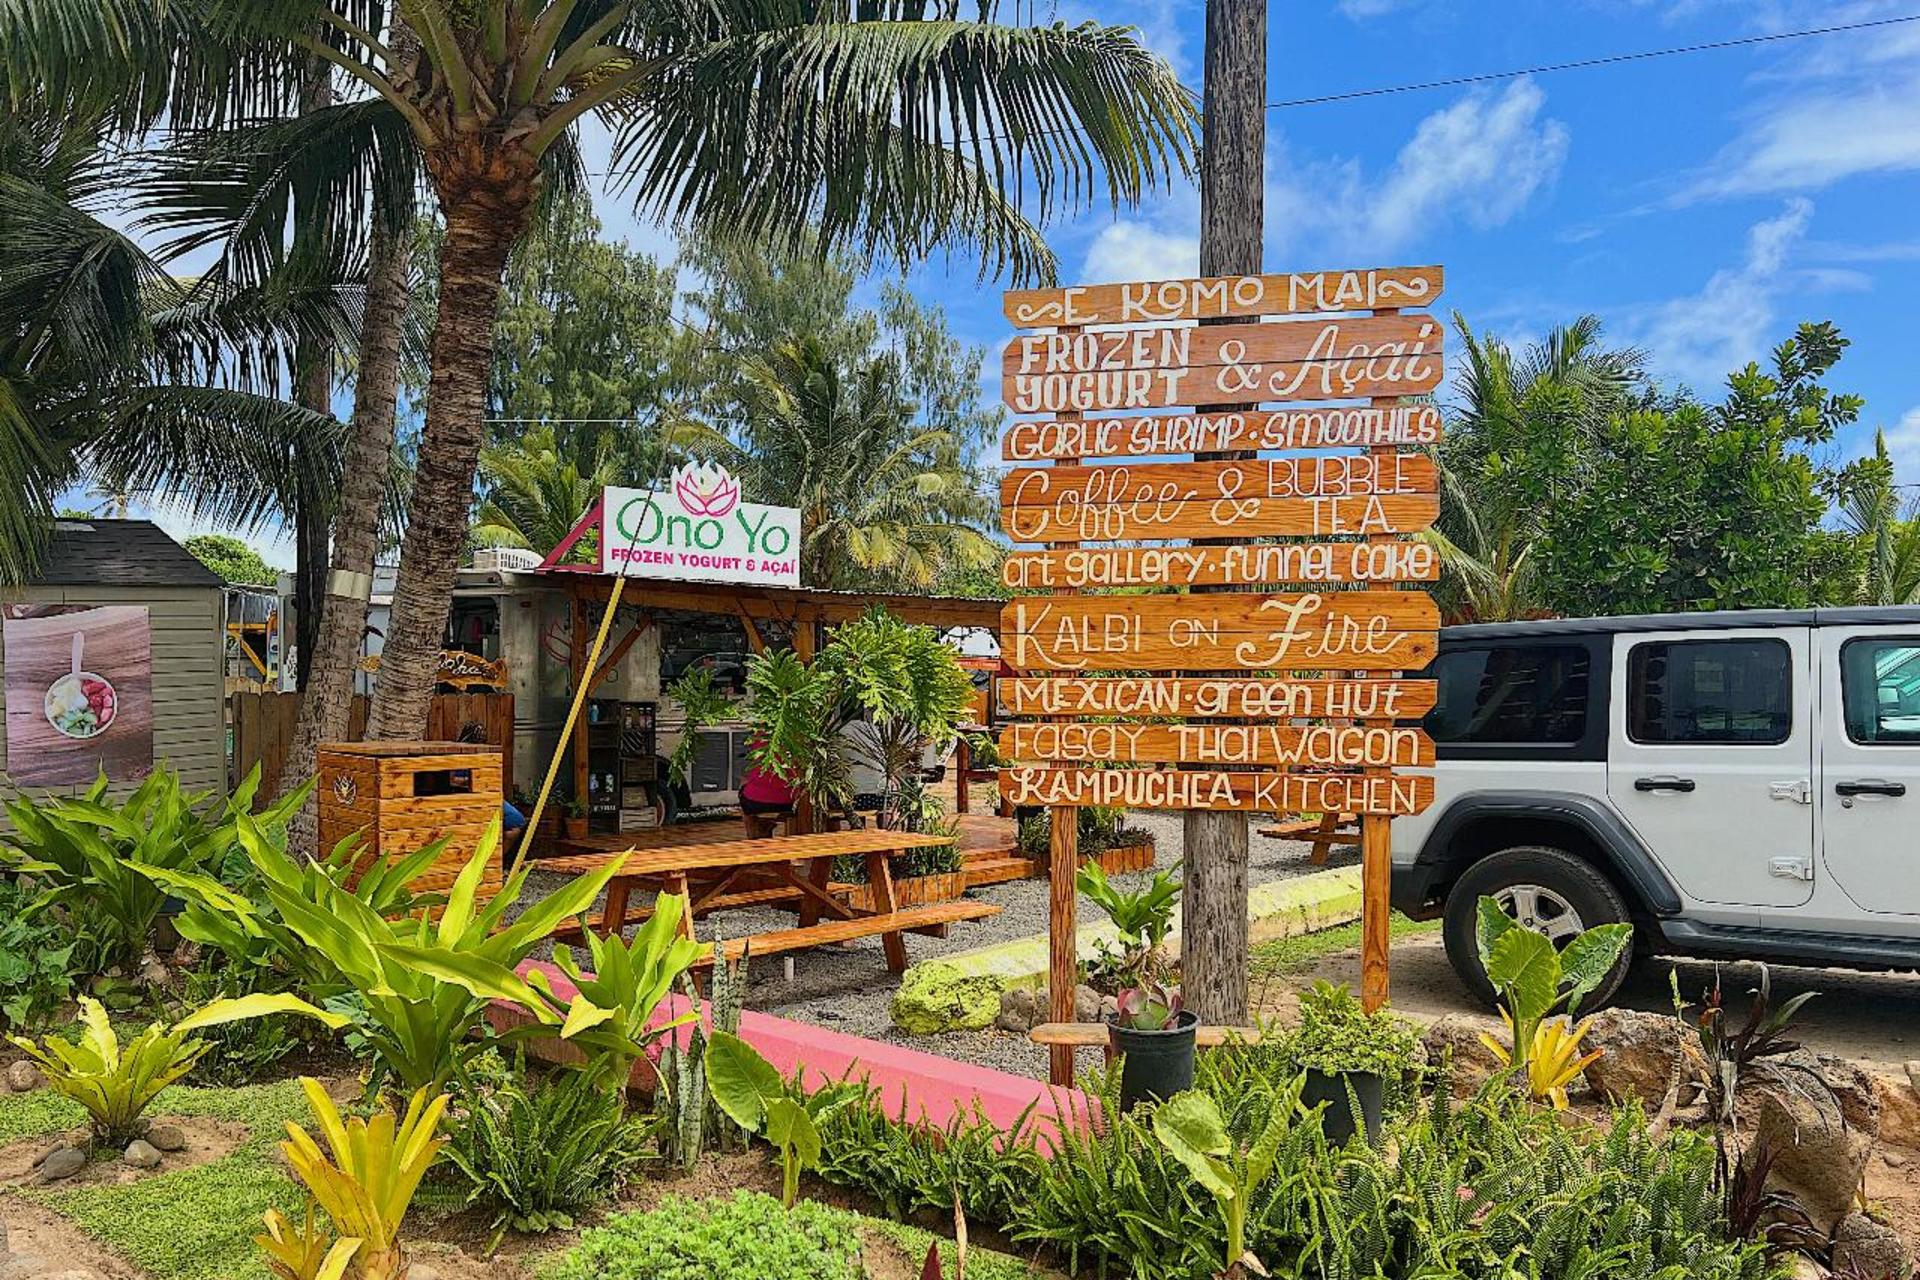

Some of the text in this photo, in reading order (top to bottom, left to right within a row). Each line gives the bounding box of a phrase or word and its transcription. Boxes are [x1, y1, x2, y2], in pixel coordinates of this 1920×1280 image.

[1122, 277, 1264, 321] KOMO
[1289, 272, 1377, 313] MAI
[1017, 327, 1192, 374] FROZEN
[1216, 339, 1261, 394] &
[1015, 367, 1189, 412] YOGURT
[1128, 414, 1246, 455] SHRIMP
[1268, 454, 1416, 498] BUBBLE
[616, 497, 790, 556] Ono Yo
[1011, 467, 1261, 541] Coffee &
[1304, 496, 1397, 536] TEA
[611, 548, 674, 565] FROZEN
[678, 554, 742, 570] YOGURT
[1003, 553, 1056, 587] art
[1351, 543, 1432, 580] cake
[1017, 593, 1409, 669] KALBI ON Fire
[1015, 678, 1180, 713] MEXICAN
[1194, 680, 1311, 716] green
[1009, 767, 1417, 813] KAMPUCHEA KITCHEN
